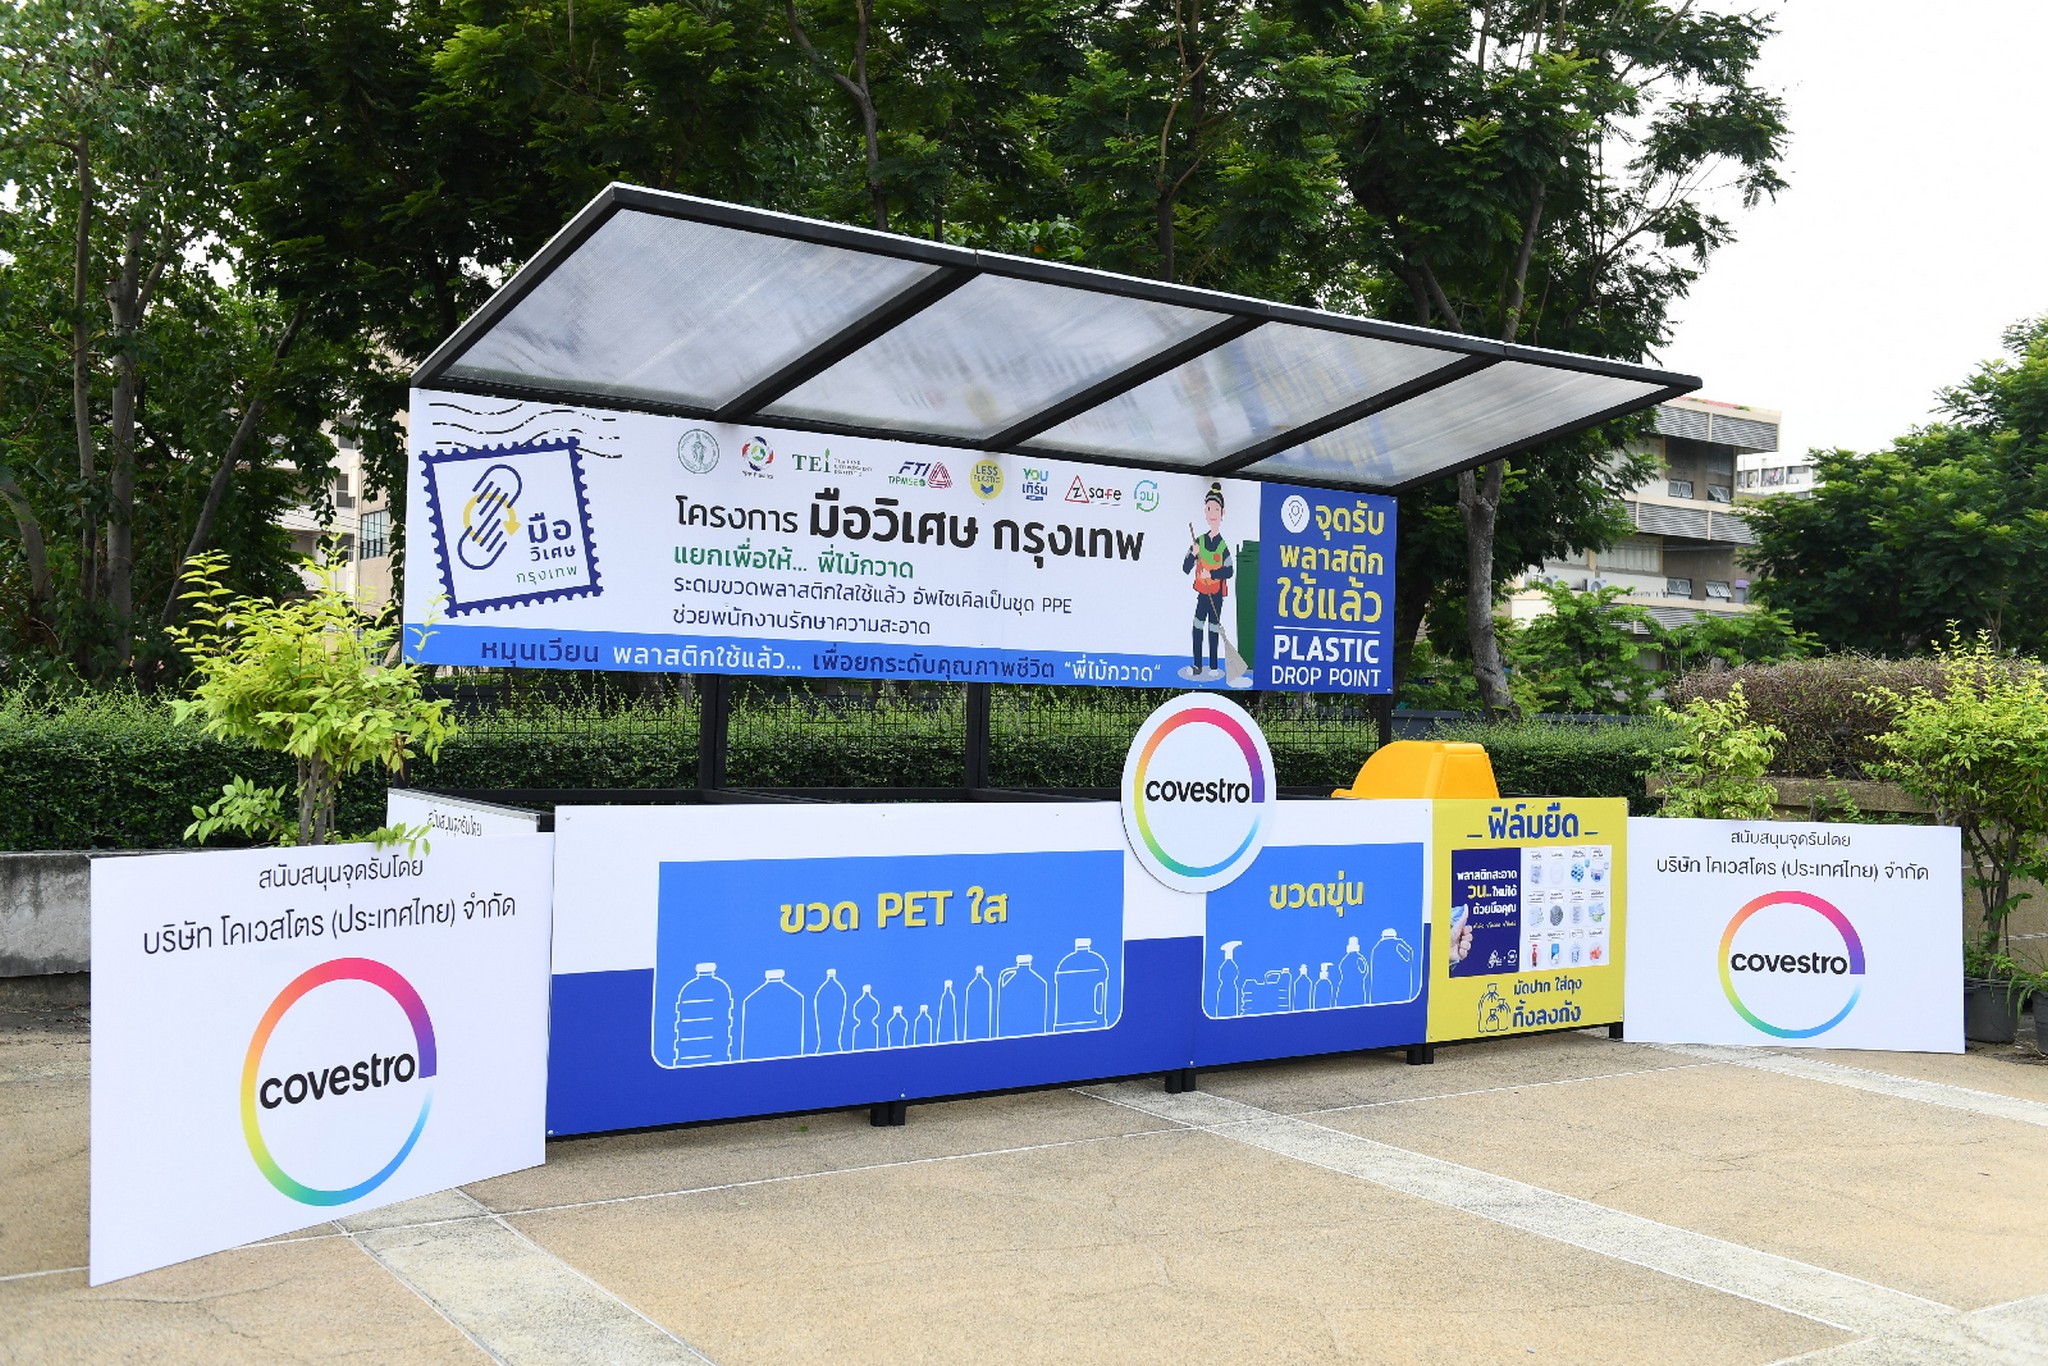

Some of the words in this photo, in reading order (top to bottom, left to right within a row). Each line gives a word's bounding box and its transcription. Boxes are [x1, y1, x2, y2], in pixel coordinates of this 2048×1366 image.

[898, 461, 931, 477] FTI
[976, 465, 999, 476] LESS
[1022, 468, 1049, 482] YOU
[1089, 487, 1122, 501] safe
[528, 512, 572, 543] มือ
[675, 495, 798, 534] โครงการ
[809, 487, 978, 548] มือวิเศษ
[992, 518, 1145, 569] กรุงเทพ
[1315, 500, 1385, 541] จุดรับ
[530, 545, 576, 561] วิเศษ
[673, 538, 807, 572] แยกเพื่อให้...
[817, 544, 914, 579] พี่ไม้กวาด
[1279, 544, 1384, 576] พลาสติก
[516, 565, 577, 585] กรุงเทพ
[673, 577, 906, 605] ระดมขวดพลาสติกใสใช้แล้ว
[913, 586, 1035, 616] อัพไซเคิลเป็นชุด
[1041, 597, 1072, 614] PPE
[1277, 572, 1383, 623] ใช้แล้ว
[672, 604, 931, 635] ช่วยพนักงานรักษาความสะอาด
[481, 638, 599, 667] หมุนเวียน
[613, 644, 802, 672] พลาสติกใช้แล้ว...
[812, 643, 1055, 678] เพื่อยกระดับคุณภาพชีวิต
[1273, 634, 1380, 664] PLASTIC
[1271, 665, 1322, 686] DROP
[1329, 667, 1382, 687] POINT
[1145, 778, 1250, 803] covestro
[1488, 802, 1579, 839] ฟิล์มยืด
[1731, 829, 1851, 849] สนับสนุนจุดรับโดย
[258, 854, 424, 891] สนับสนุนจุดรับโดย
[1457, 868, 1518, 881] พลาสติกสะอาด
[1657, 856, 1701, 873] บริษัท
[1706, 856, 1777, 876] โคเวสโตร
[1782, 859, 1879, 882] (ประเทศไทย)
[1884, 861, 1930, 880] จำกัด
[1269, 870, 1364, 917] ขวดขุ่น
[143, 921, 213, 954] บริษัท
[220, 908, 325, 946] โคเวสโตร
[331, 898, 456, 940] (ประเทศไทย)
[463, 892, 517, 920] จำกัด
[780, 900, 861, 934] ขวด
[877, 890, 954, 929] PET
[966, 885, 1009, 925] ใส
[1731, 952, 1848, 975] covestro
[1513, 979, 1551, 995] มัดปาก
[1554, 975, 1582, 994] ใส่ถุง
[1512, 999, 1582, 1028] ทิ้งลงถัง
[259, 1053, 416, 1110] covestro
